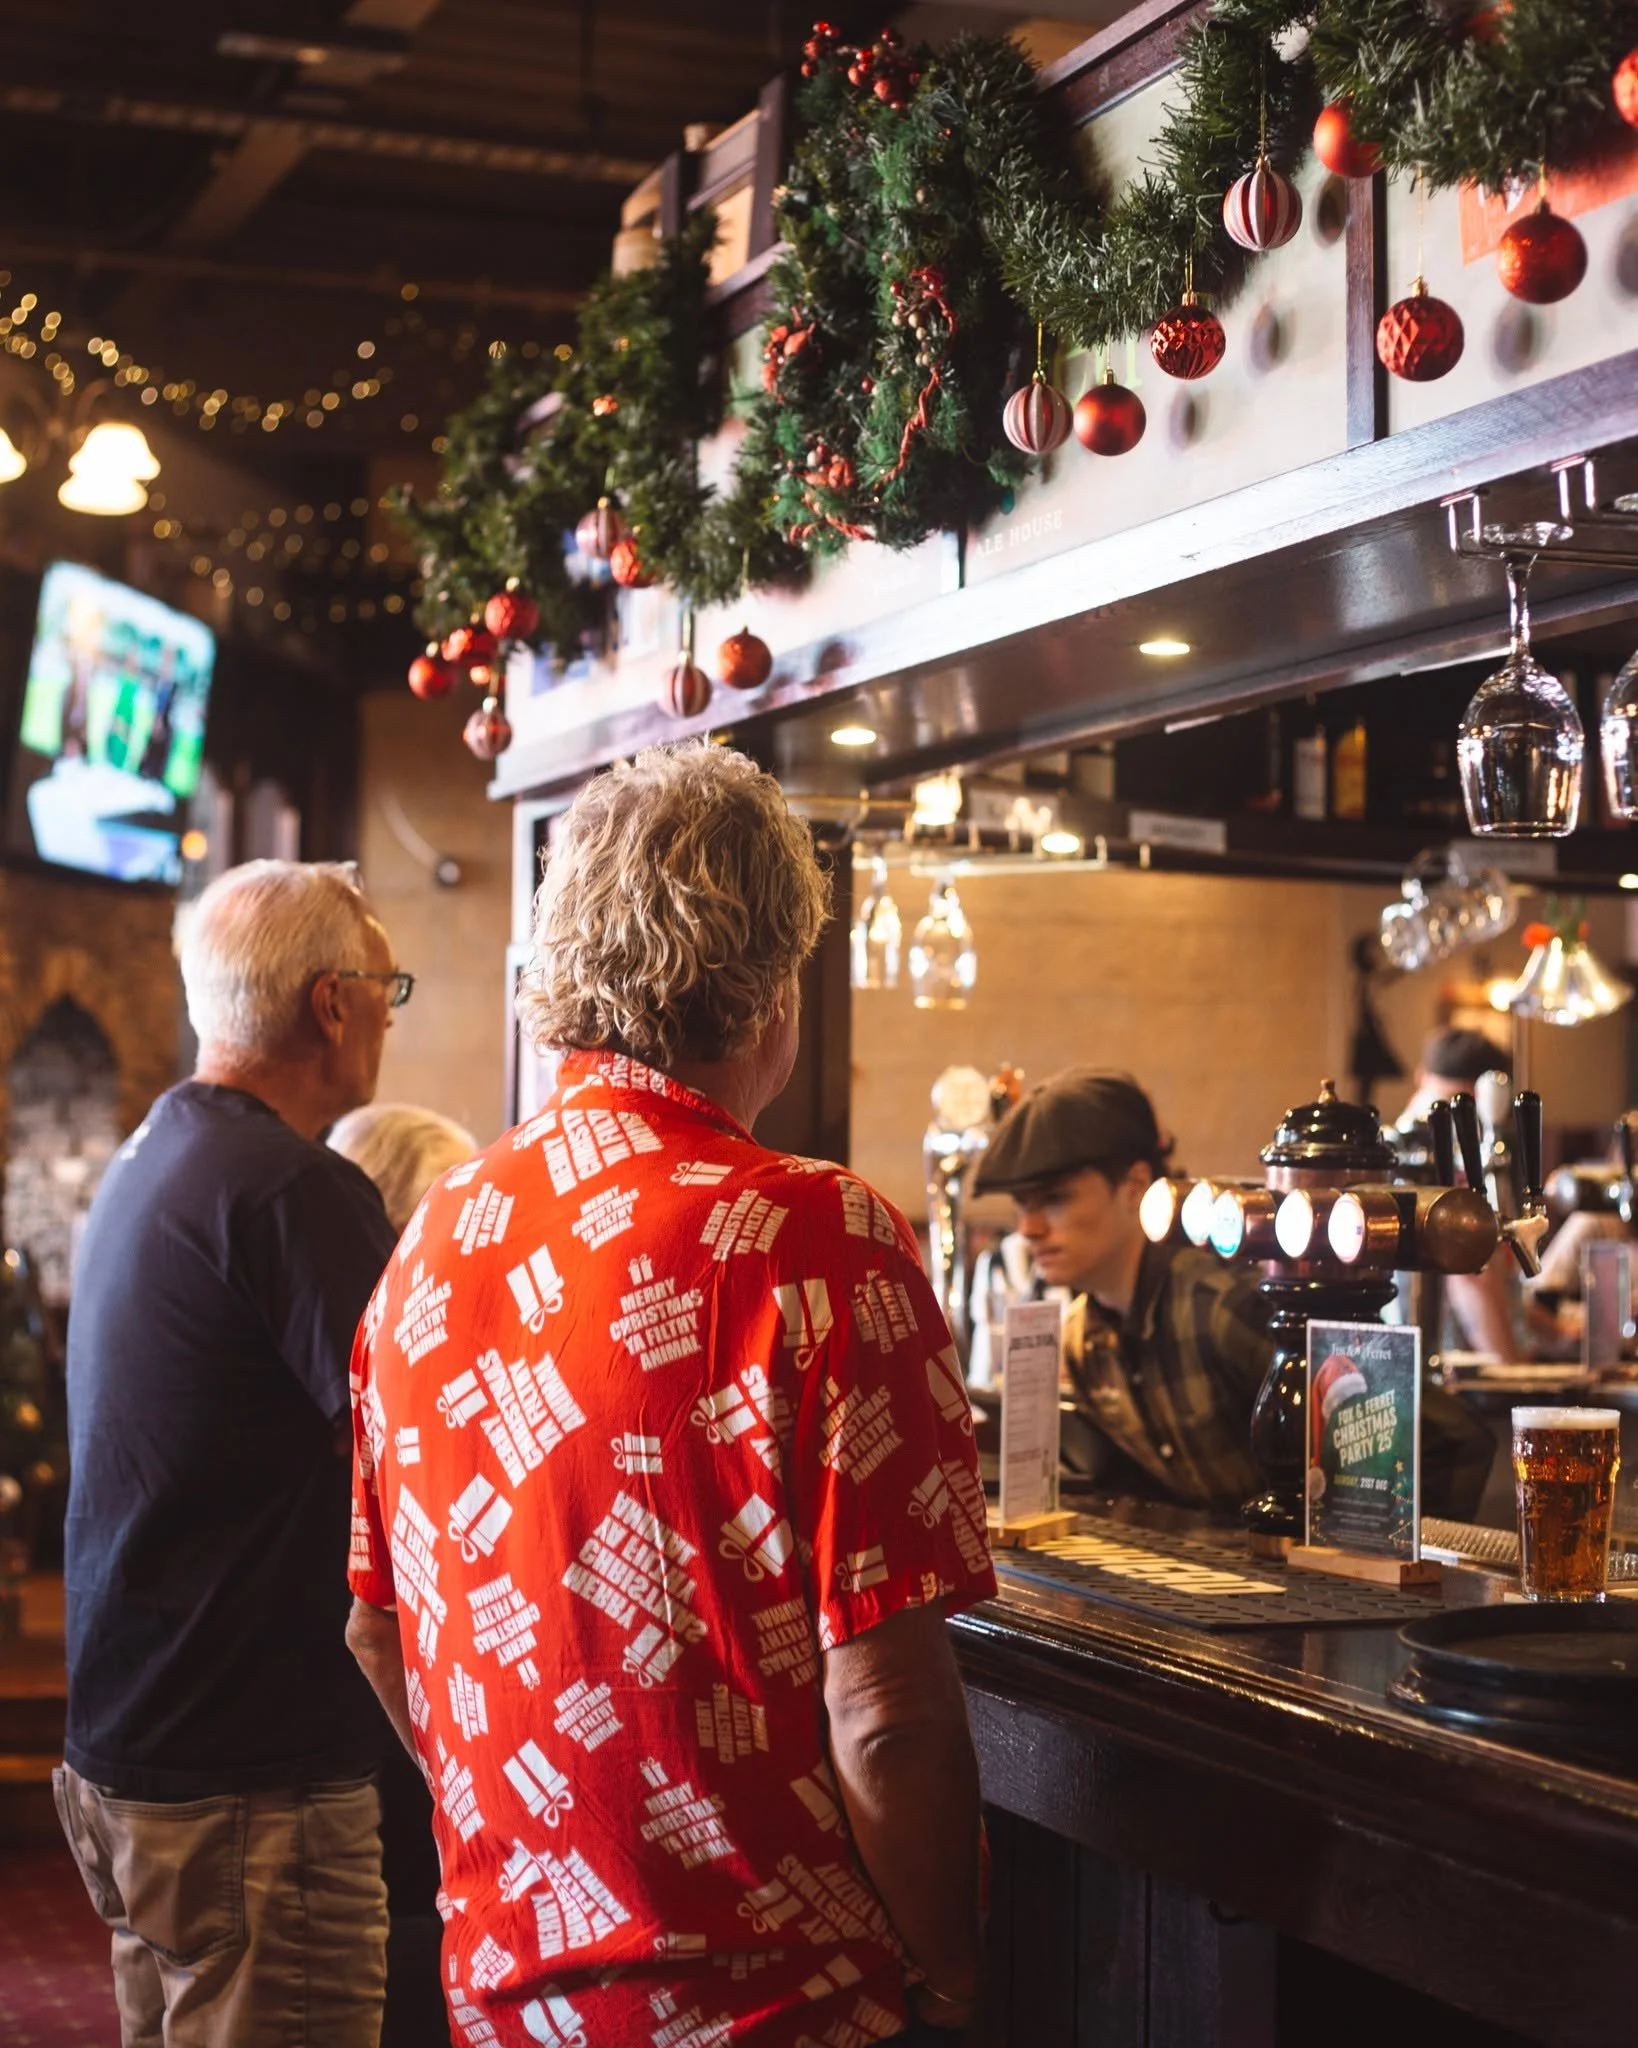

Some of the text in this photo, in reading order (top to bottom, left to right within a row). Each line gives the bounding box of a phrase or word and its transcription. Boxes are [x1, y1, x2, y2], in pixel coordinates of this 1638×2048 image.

[1009, 509, 1063, 548] HOUSE
[571, 1187, 640, 1237] CHRISTMAS
[580, 1184, 619, 1217] MERRY
[581, 1201, 633, 1243] YA FILTHY
[590, 1216, 635, 1252] ANIMAL
[609, 1288, 703, 1342] CHRISTMAS
[620, 1276, 675, 1314] MERRY
[625, 1311, 700, 1356] YA FILTHY
[640, 1334, 702, 1373] ANIMAL
[477, 1348, 544, 1472] CHRISTMAS
[508, 1356, 564, 1456] YA FILTHY
[532, 1350, 588, 1435] ANIMAL
[821, 1384, 863, 1438] MERRY
[1338, 1406, 1354, 1427] FOX
[1365, 1388, 1396, 1415] FERRET
[819, 1385, 891, 1468] CHRISTMAS
[831, 1407, 893, 1475] YA FILTHY
[1332, 1406, 1398, 1450] CHRISTMAS
[480, 1412, 527, 1489] MERRY
[850, 1429, 903, 1485] ANIMAL
[1339, 1435, 1375, 1469] PARTY
[466, 1572, 513, 1614] ANIMAL
[472, 1588, 527, 1633] YA FILTHY
[473, 1602, 541, 1655] CHRISTMAS
[496, 1628, 537, 1668] MERRY
[552, 1681, 612, 1736] CHRISTMAS
[553, 1677, 590, 1713] MERRY
[566, 1699, 616, 1743] YA FILTHY
[582, 1715, 625, 1753] ANIMAL
[640, 1793, 726, 1843] CHRISTMAS
[644, 1780, 696, 1815] MERRY
[659, 1816, 728, 1856] YA FILTHY
[679, 1836, 736, 1872] ANIMAL
[530, 1890, 565, 1961] MERRY
